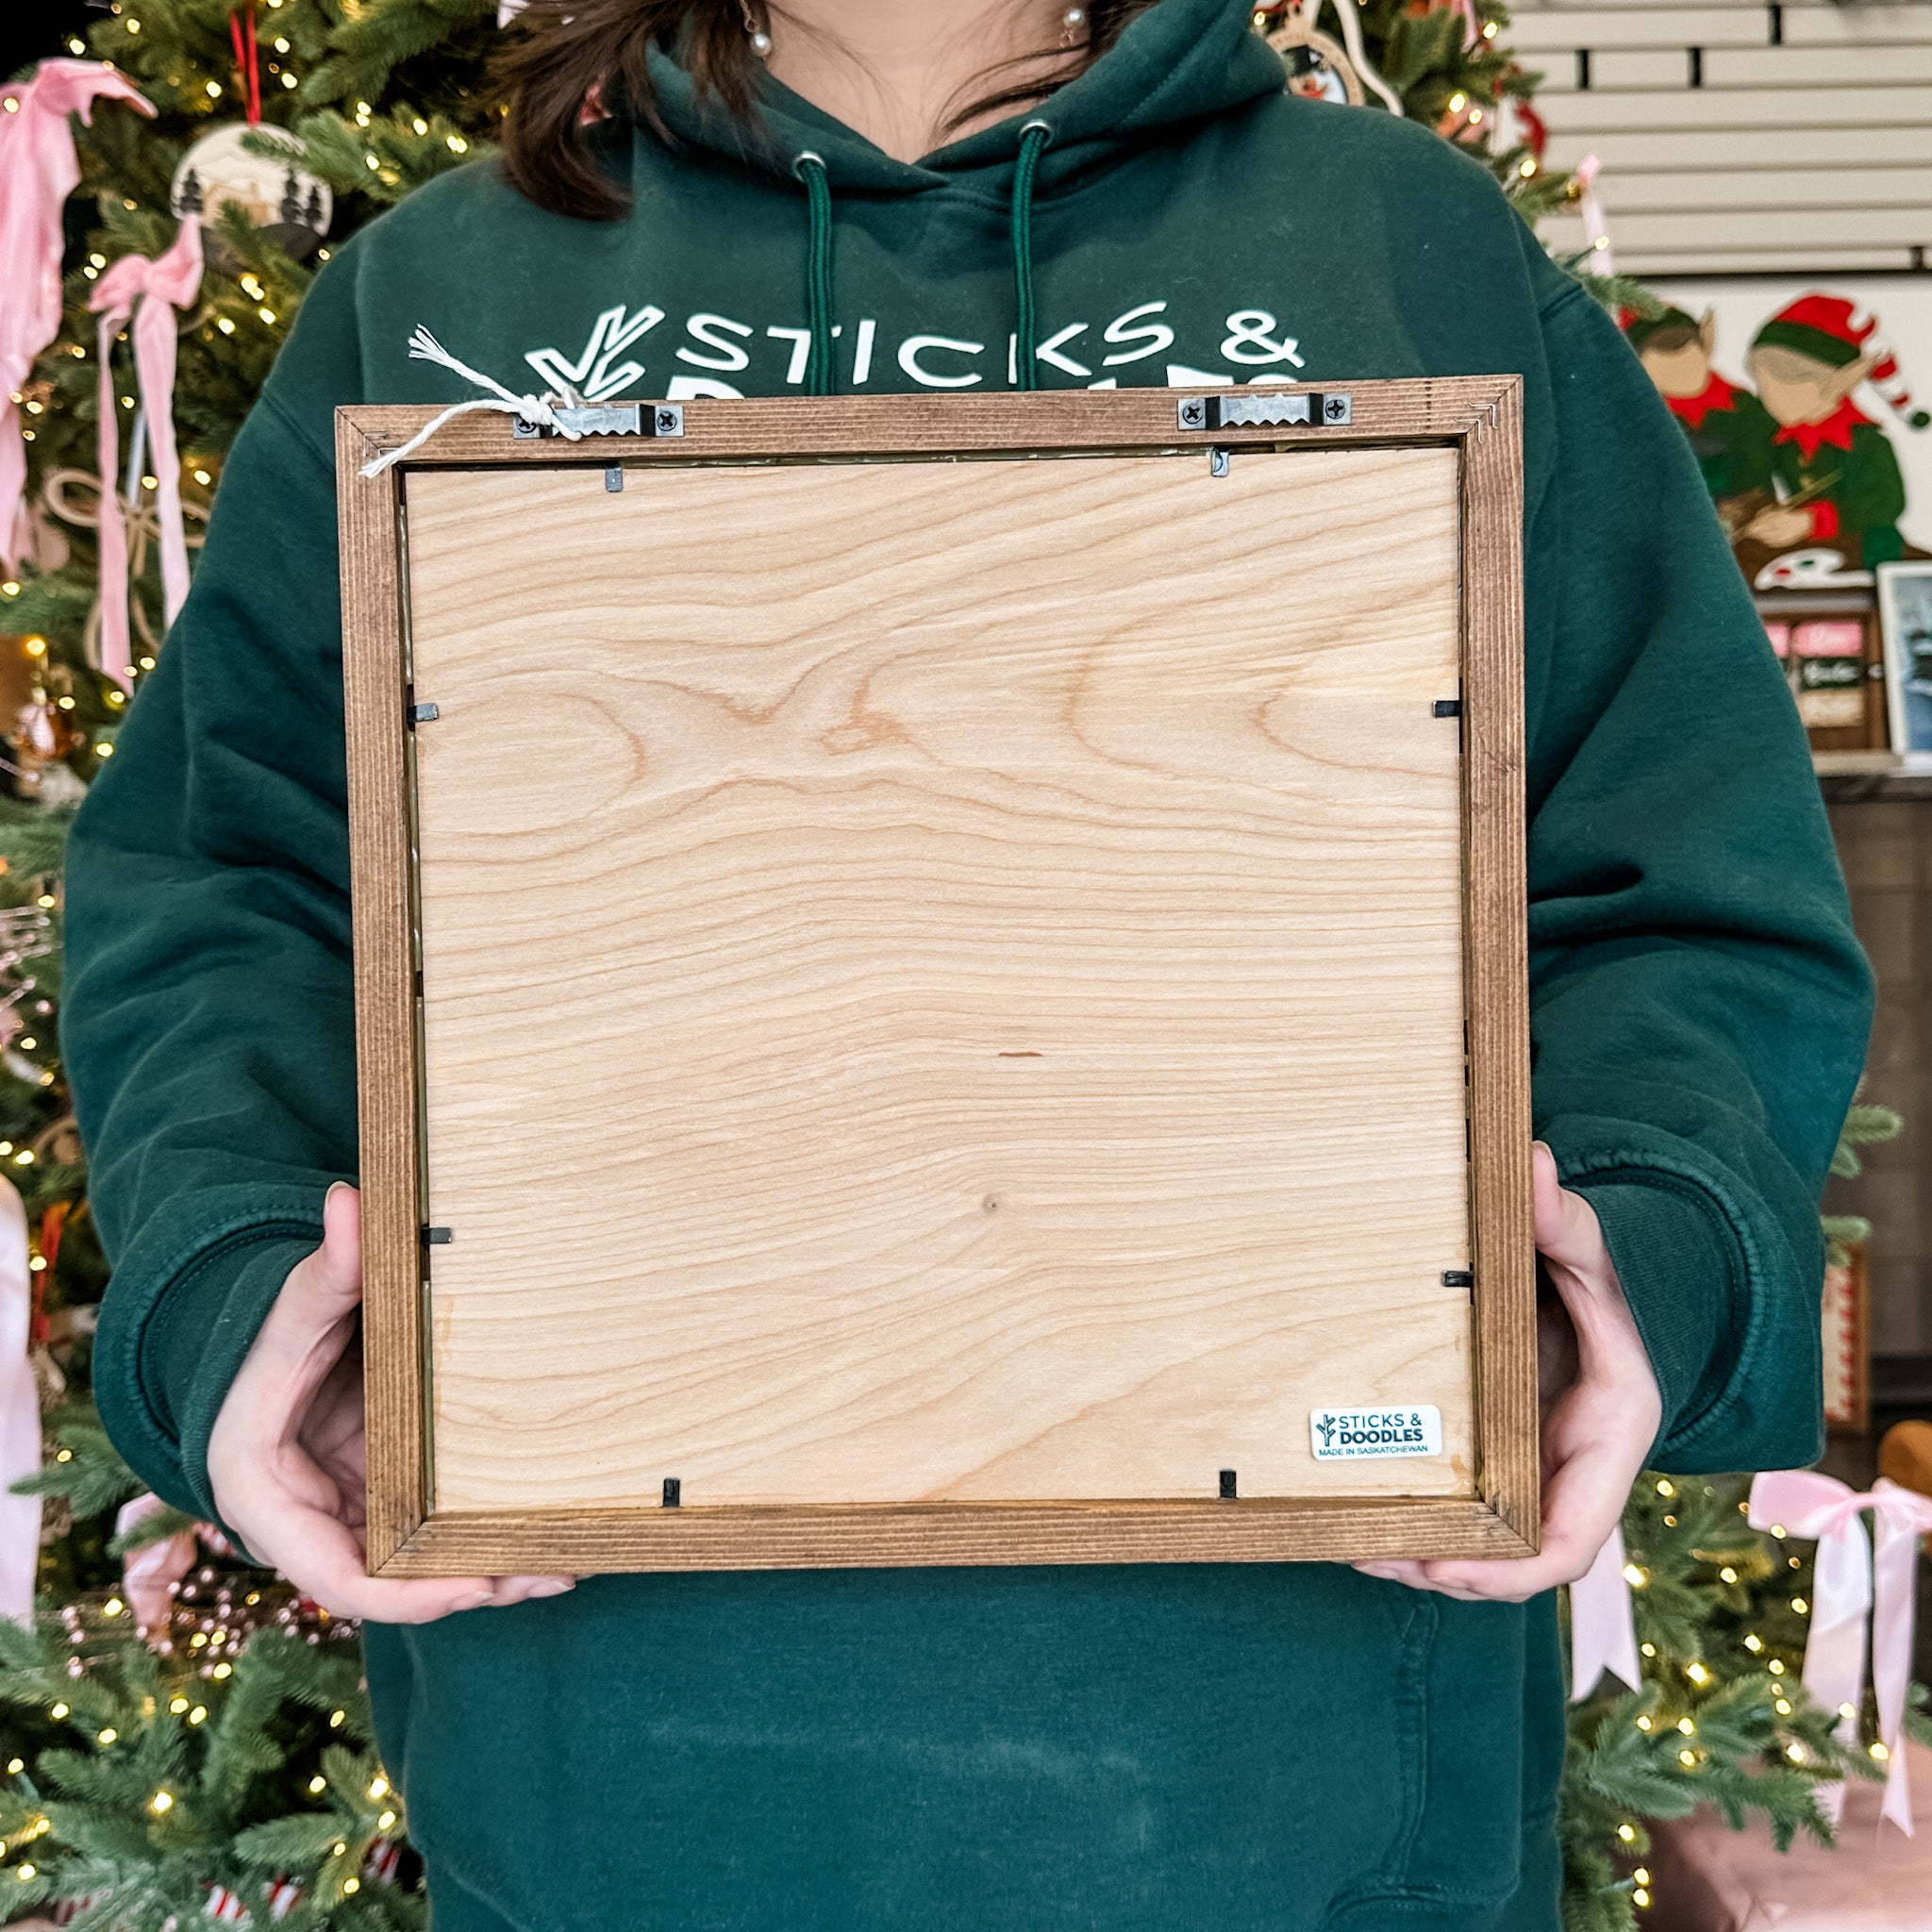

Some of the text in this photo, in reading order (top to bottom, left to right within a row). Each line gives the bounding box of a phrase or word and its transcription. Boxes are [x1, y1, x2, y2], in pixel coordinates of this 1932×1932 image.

[675, 300, 1175, 388] STICKS
[1220, 308, 1306, 369] &
[1339, 1412, 1423, 1429] STICKS &
[1340, 1428, 1424, 1444] DOODLES
[1319, 1444, 1428, 1457] MADE IN SASKATCHEWAN
